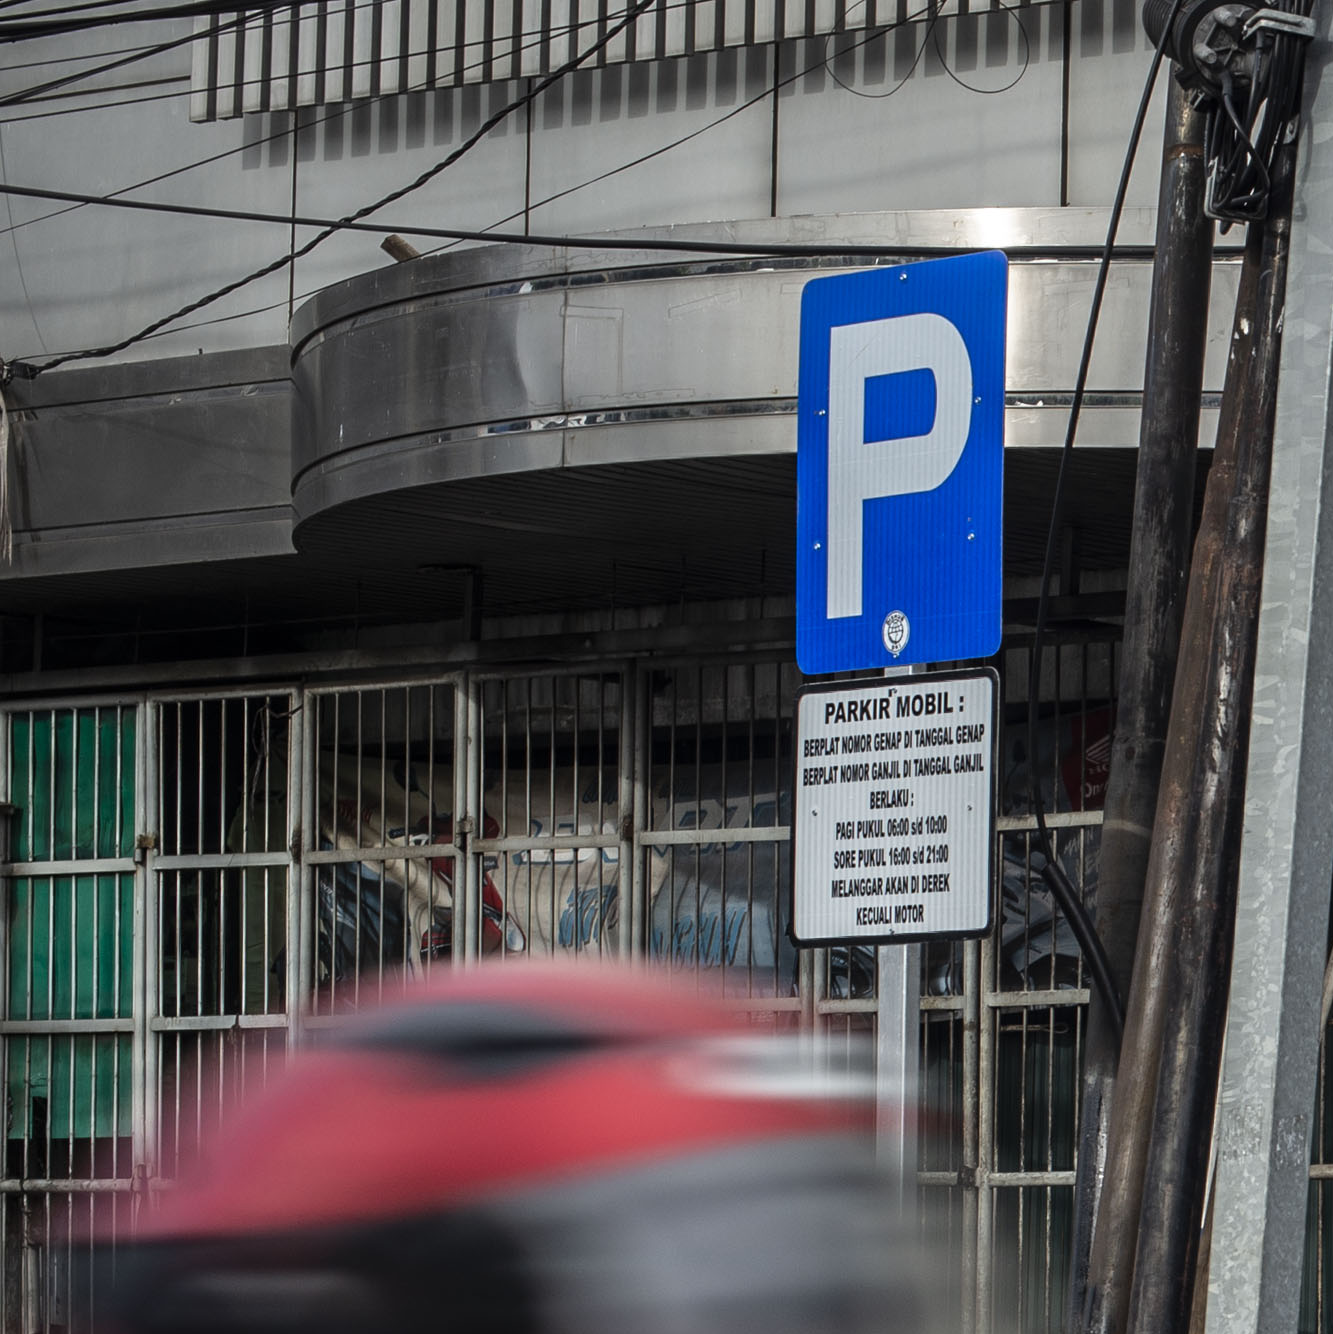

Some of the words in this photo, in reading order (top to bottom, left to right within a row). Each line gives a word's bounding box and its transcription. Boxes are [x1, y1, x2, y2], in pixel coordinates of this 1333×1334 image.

[826, 312, 973, 620] P
[825, 698, 890, 724] PARKIR
[896, 691, 953, 718] MOBIL
[803, 736, 840, 758] BERPLAT
[842, 733, 872, 754] NOMOR
[874, 731, 902, 752] GENAP
[904, 730, 913, 749] DI
[915, 726, 953, 748] TANGGAL
[956, 723, 985, 743] GENAP
[803, 765, 838, 786] BERPLAT
[840, 763, 870, 783] NOMOR
[871, 760, 901, 781] GANJIL
[903, 759, 912, 778] DI
[914, 756, 952, 777] TANGGAL
[953, 753, 984, 774] GANJIL
[870, 788, 909, 810] BERLAKU
[836, 819, 855, 840] PAGI
[857, 818, 885, 839] PUKUL
[887, 817, 909, 837] 06:00
[911, 816, 923, 835] s/d
[925, 814, 947, 834] 10:00
[834, 849, 856, 869] SORE
[858, 848, 886, 868] PUKUL
[889, 846, 910, 866] 16:00
[912, 845, 924, 864] s/d
[926, 844, 948, 863] 21:00
[832, 877, 883, 898] MELANGGAR
[885, 875, 909, 896] AKAN
[911, 875, 919, 893] DI
[922, 873, 950, 893] DEREK
[856, 904, 892, 925] KECUALI
[894, 904, 924, 924] MOTOR
